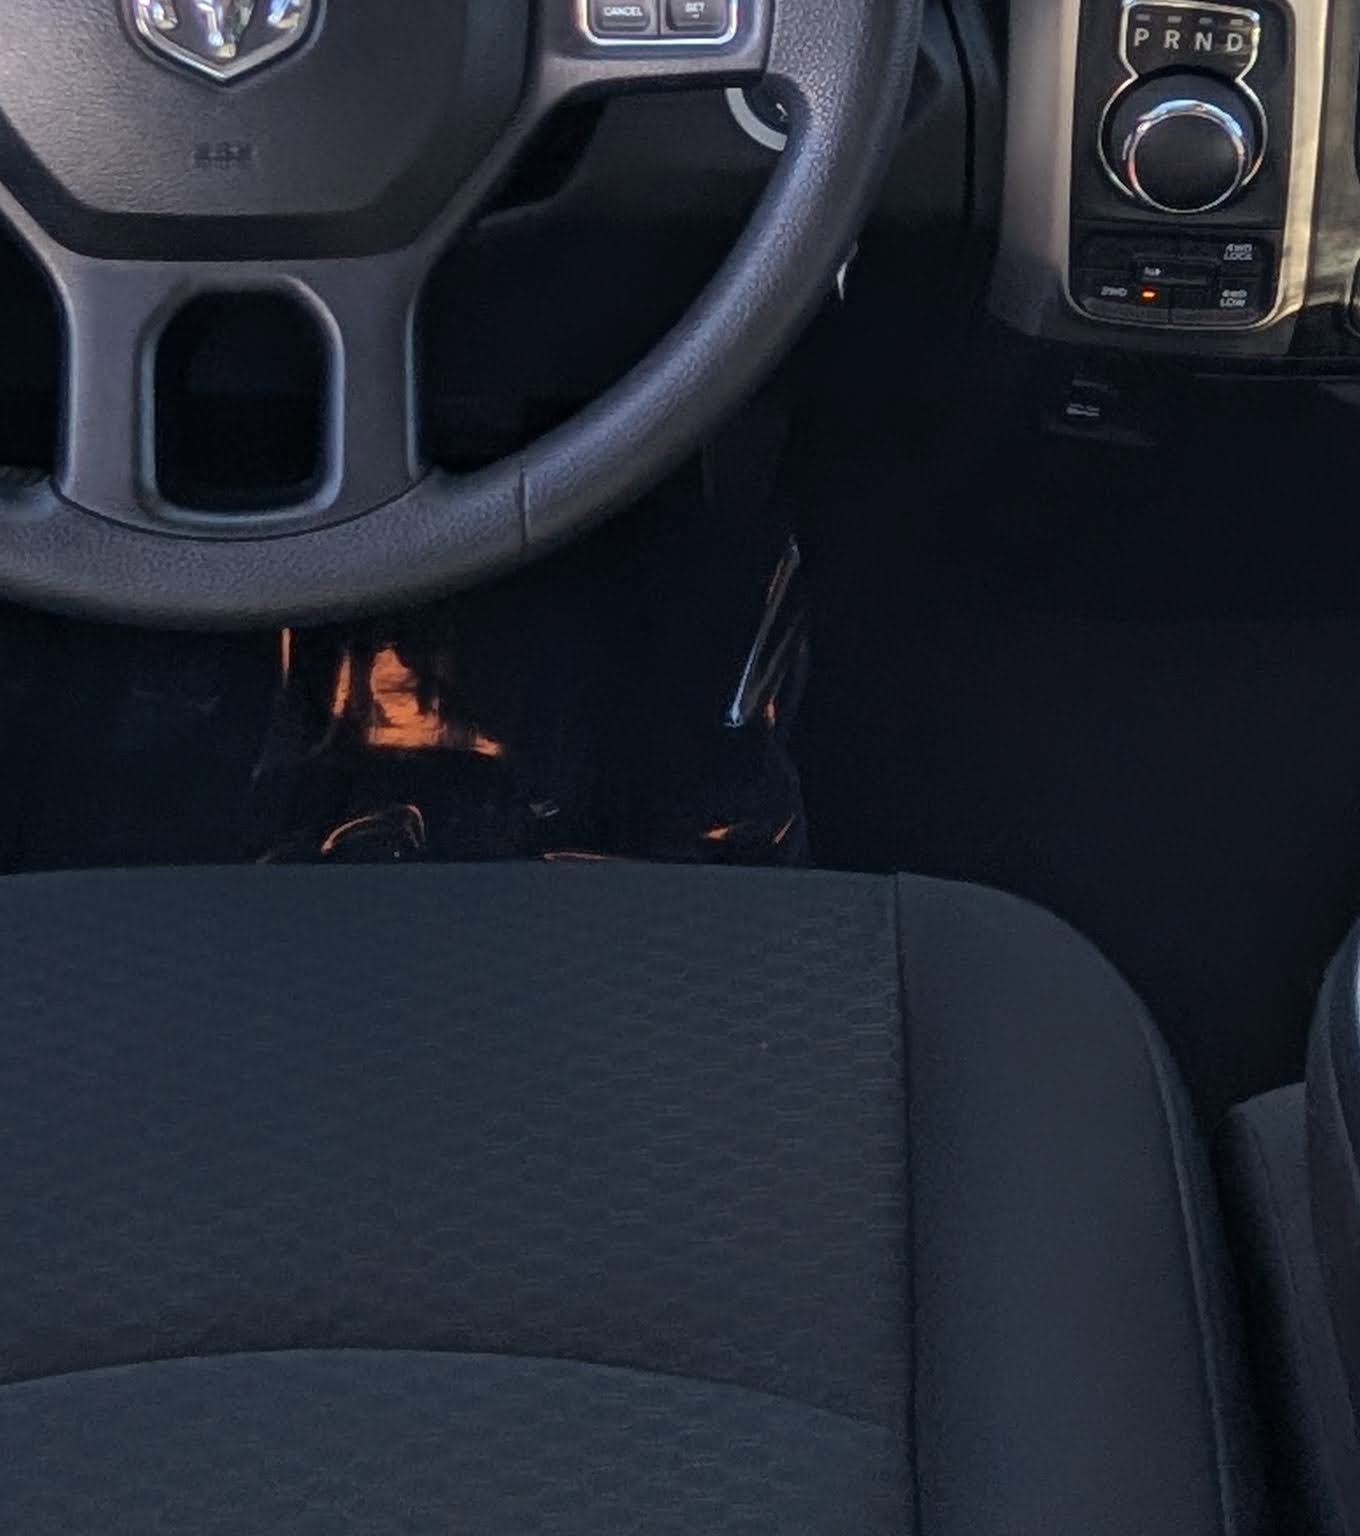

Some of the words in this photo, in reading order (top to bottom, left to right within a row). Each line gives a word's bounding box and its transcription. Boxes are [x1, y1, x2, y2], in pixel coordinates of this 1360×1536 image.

[1133, 27, 1150, 48] P
[1163, 29, 1181, 50] R
[1195, 31, 1214, 52] N
[1225, 33, 1244, 53] D
